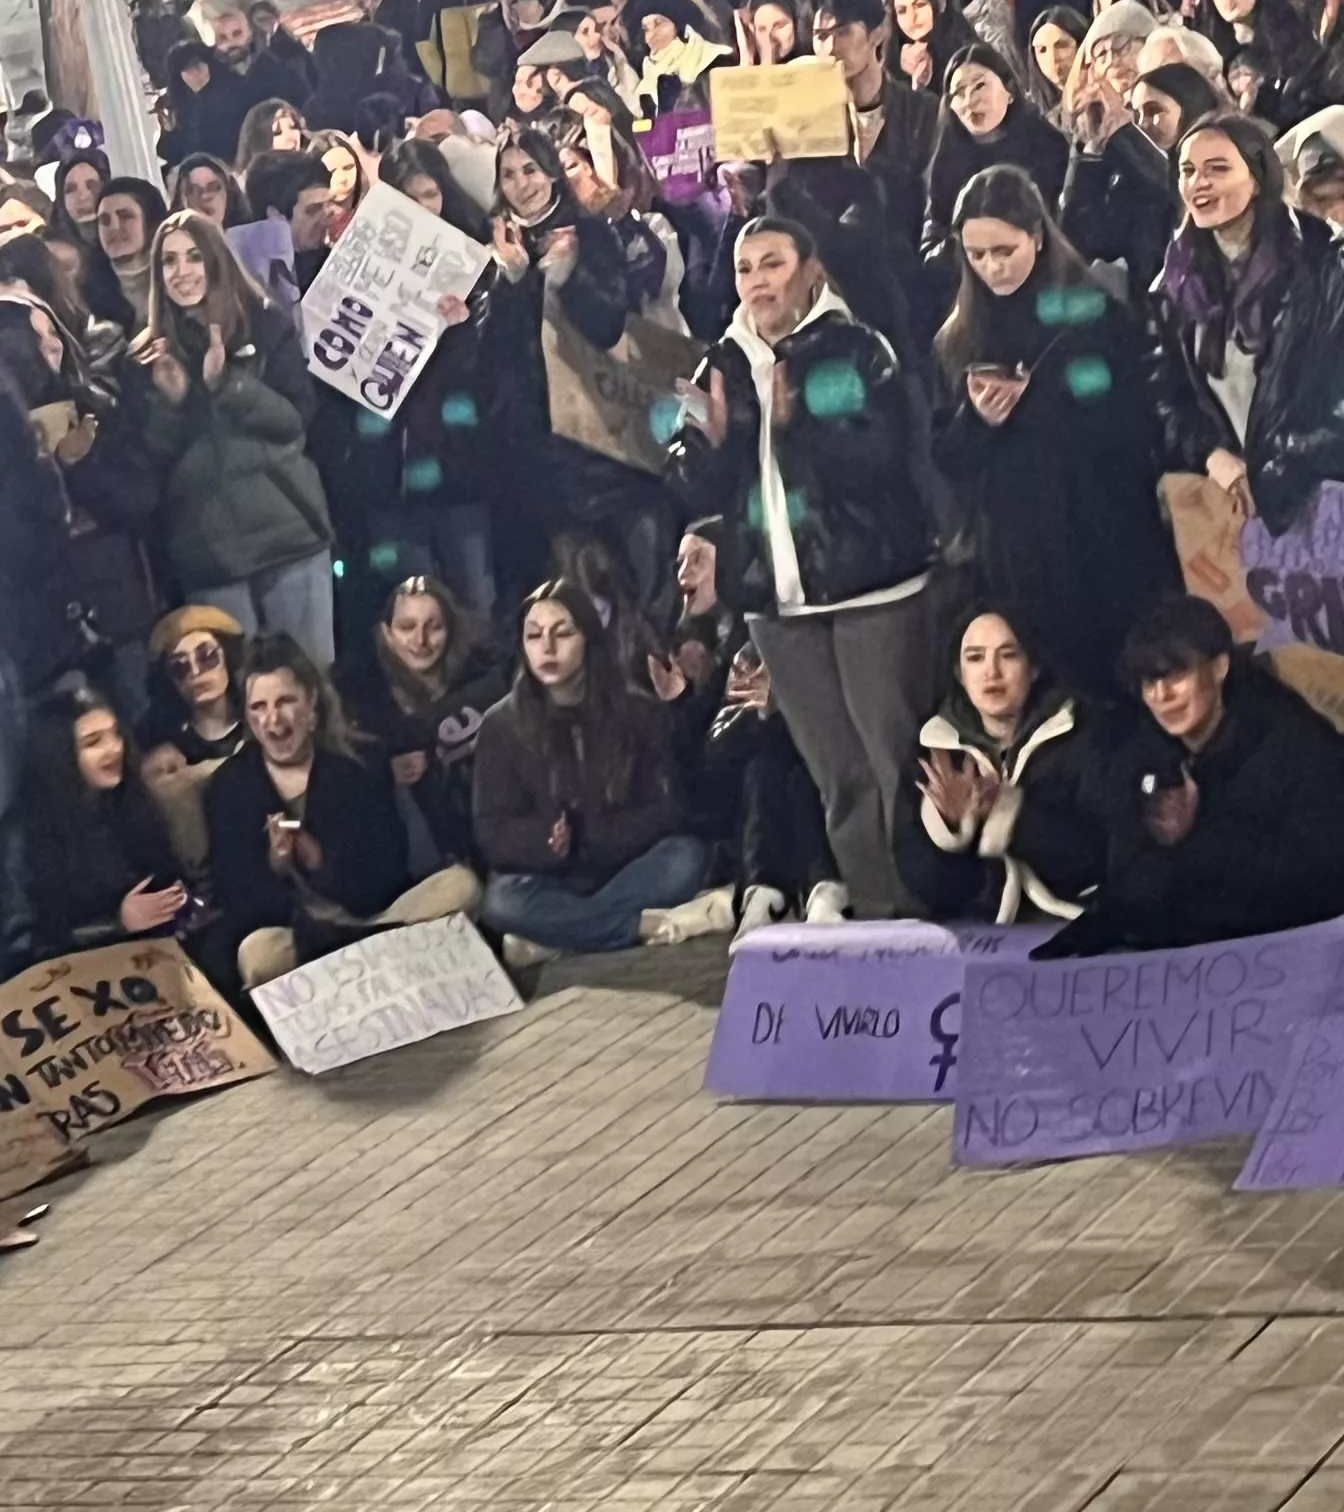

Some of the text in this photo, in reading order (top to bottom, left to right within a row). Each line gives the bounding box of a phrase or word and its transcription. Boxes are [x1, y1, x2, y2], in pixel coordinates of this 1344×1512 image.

[978, 942, 1287, 1022] QUEREMOS
[0, 995, 82, 1058] SE
[1080, 999, 1273, 1072] VIVIR
[964, 1096, 1040, 1149] NO
